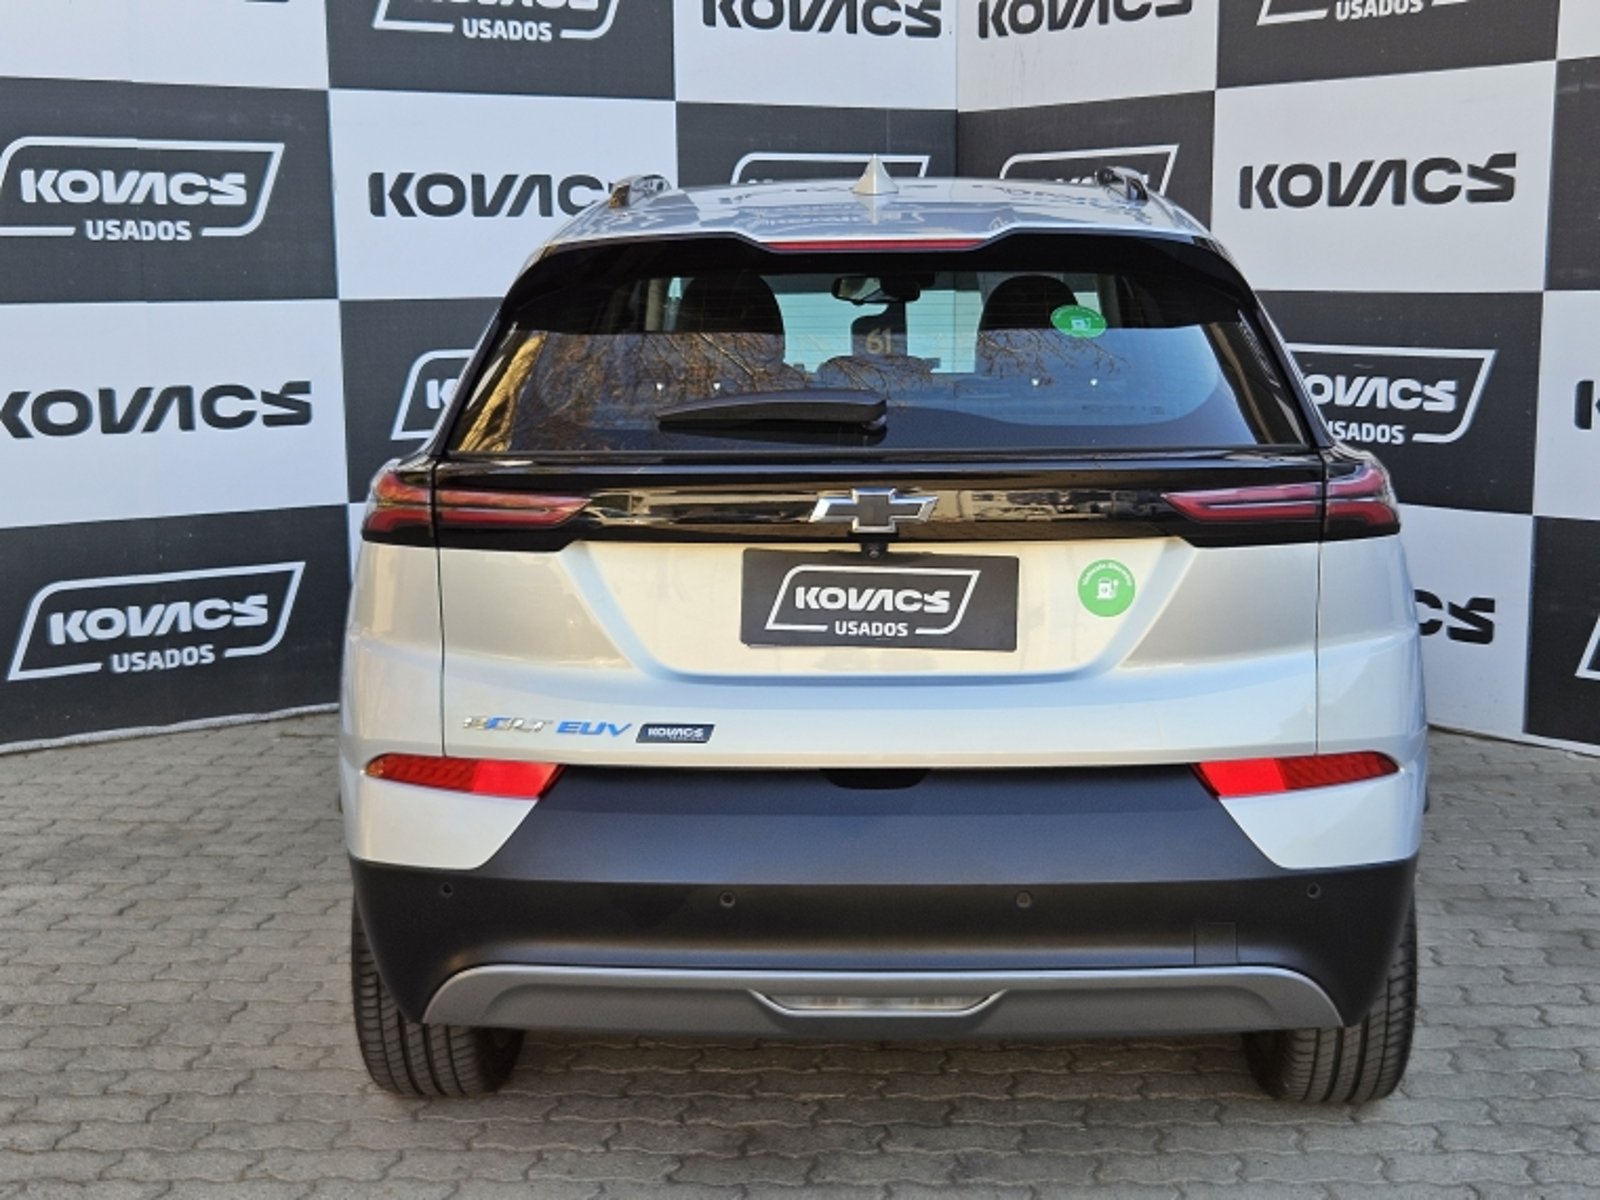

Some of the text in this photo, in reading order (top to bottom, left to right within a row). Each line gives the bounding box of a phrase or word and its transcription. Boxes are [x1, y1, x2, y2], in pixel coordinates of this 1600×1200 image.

[702, 0, 942, 38] KOVACS
[1335, 0, 1424, 21] USADOS
[462, 18, 553, 42] USADOS
[20, 169, 248, 206] KOVACS
[368, 172, 614, 217] KOVAC
[1238, 152, 1517, 209] KOVACS
[85, 220, 193, 241] USADOS
[1302, 374, 1458, 412] OVACS
[795, 586, 951, 614] KOVACS
[47, 595, 269, 645] KOVACS
[834, 620, 909, 637] USADOS
[111, 644, 216, 674] USADOS
[556, 720, 631, 738] EUV
[647, 727, 704, 738] KOVACS
